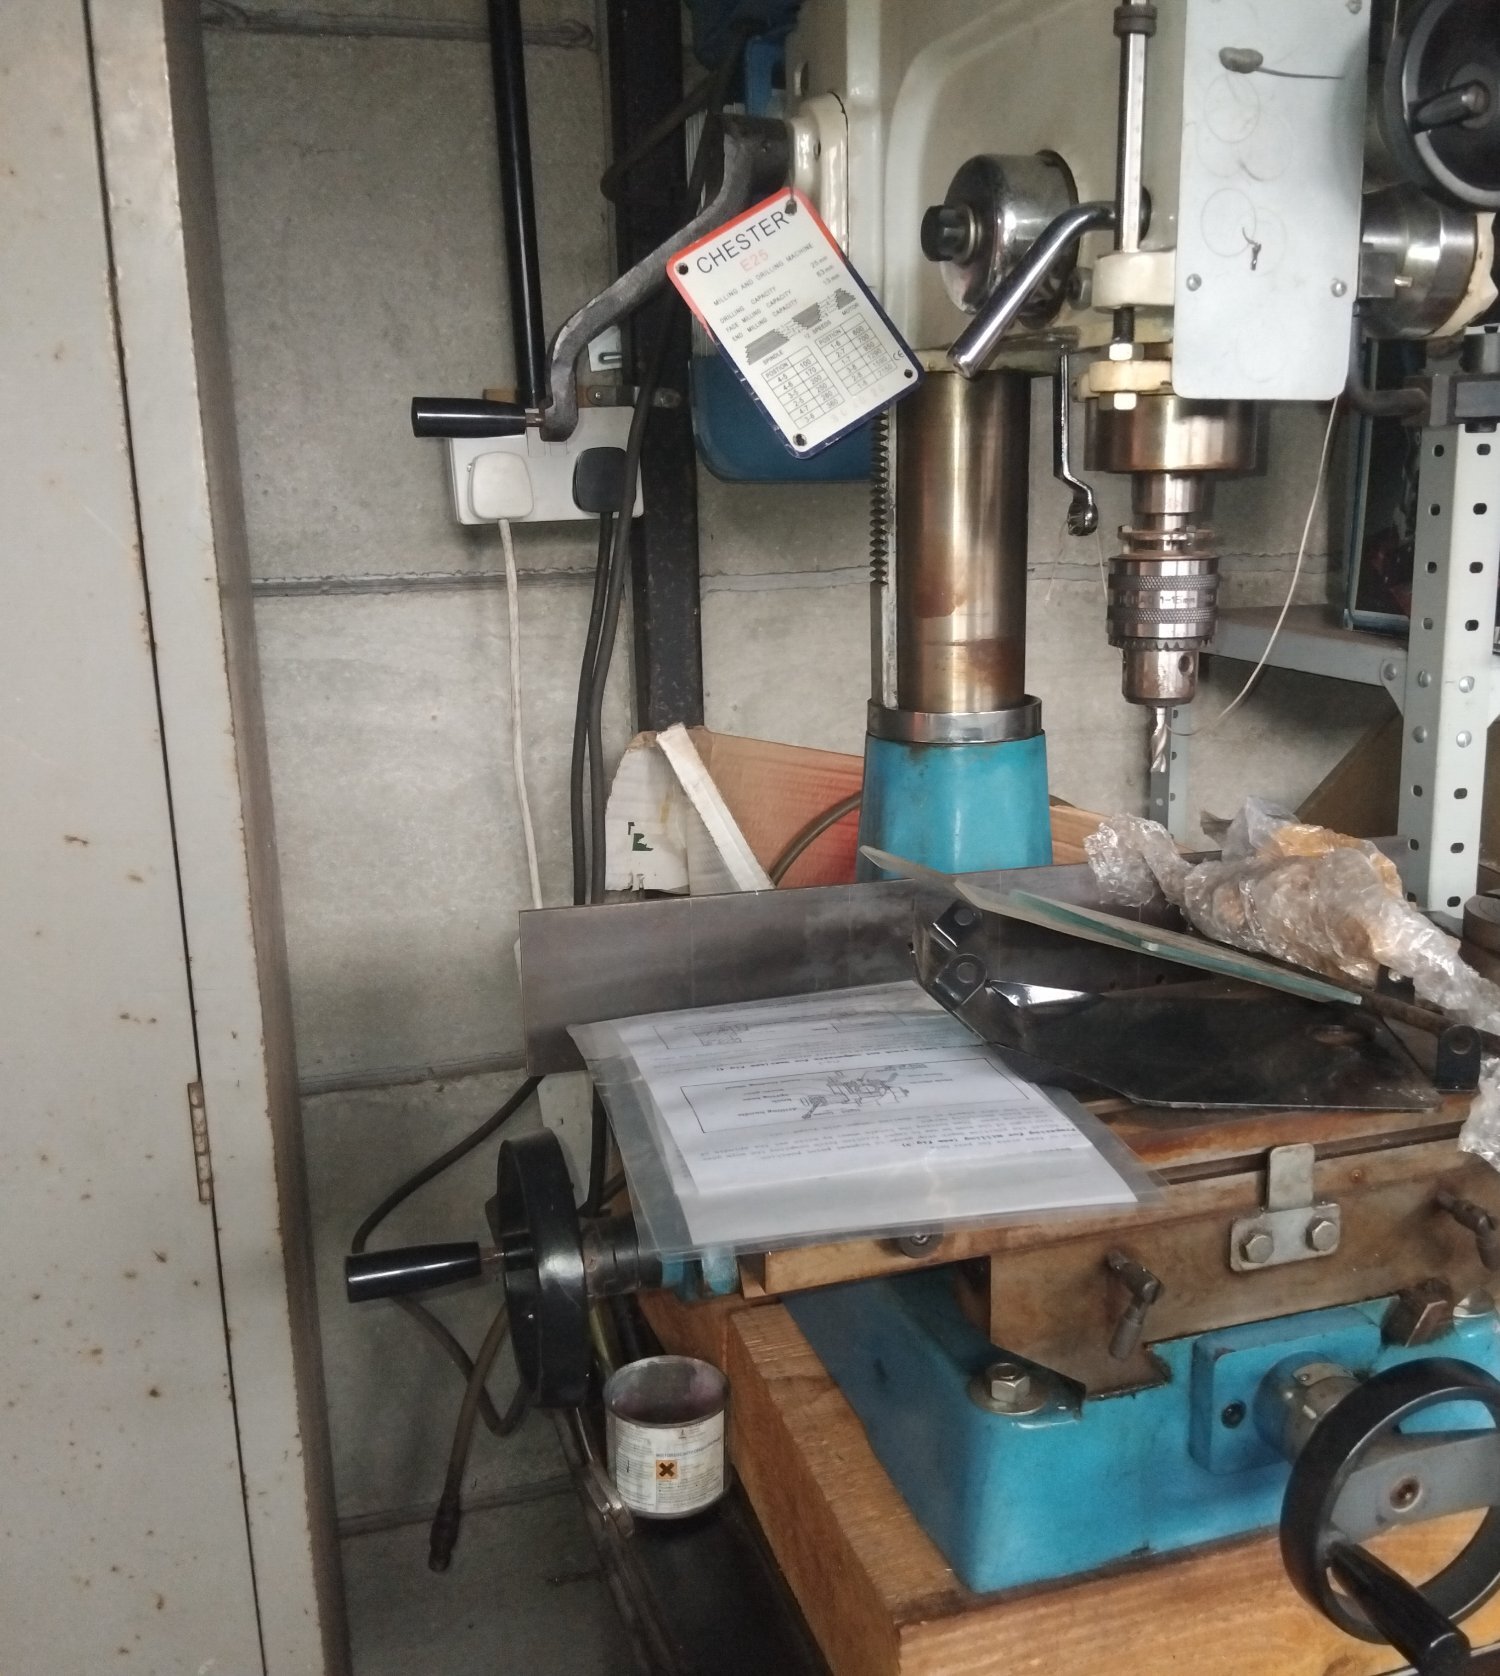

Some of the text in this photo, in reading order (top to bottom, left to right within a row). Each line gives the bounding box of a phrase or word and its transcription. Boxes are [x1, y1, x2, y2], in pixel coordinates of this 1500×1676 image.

[696, 210, 791, 274] CHESTER
[740, 248, 769, 272] E25
[713, 242, 814, 307] MILLING AND DRILLING MACHINE
[719, 305, 745, 324] DRILLING
[750, 286, 777, 305] CAPACITY
[741, 308, 762, 324] MILLING
[765, 289, 793, 309] CAPACITY
[841, 302, 860, 316] MOTOR
[732, 332, 744, 342] END
[746, 317, 768, 333] MILLING
[772, 298, 799, 318] CAPACITY
[812, 319, 832, 334] SPEEDS
[762, 349, 784, 365] SPINDLE
[799, 358, 812, 369] 100
[805, 366, 817, 377] 170
